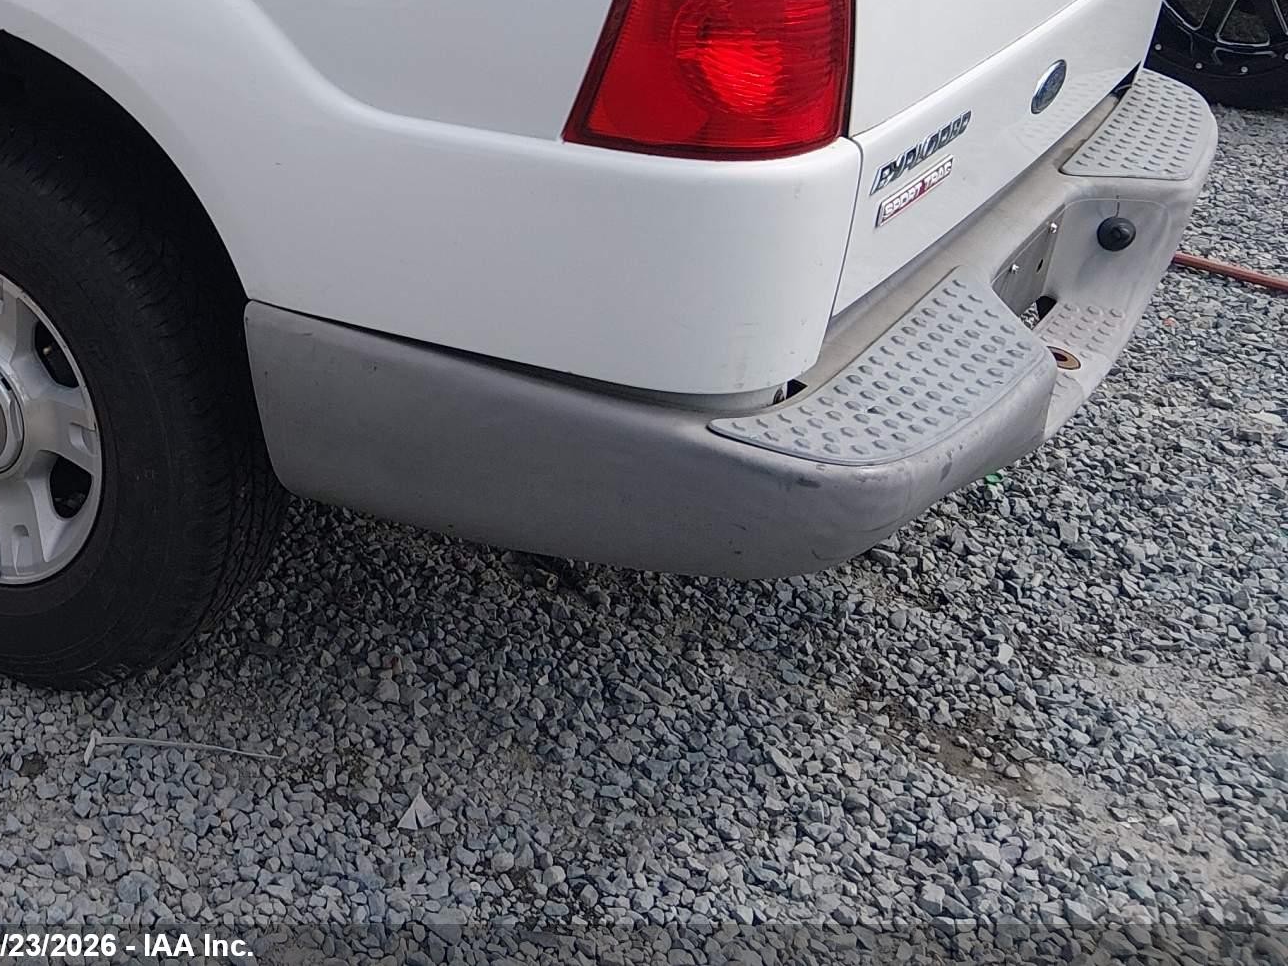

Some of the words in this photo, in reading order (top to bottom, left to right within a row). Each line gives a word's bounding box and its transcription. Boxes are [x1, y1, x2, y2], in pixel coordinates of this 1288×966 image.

[870, 110, 972, 195] EXPLORER
[882, 184, 923, 219] SPORT
[923, 161, 953, 192] TRAC
